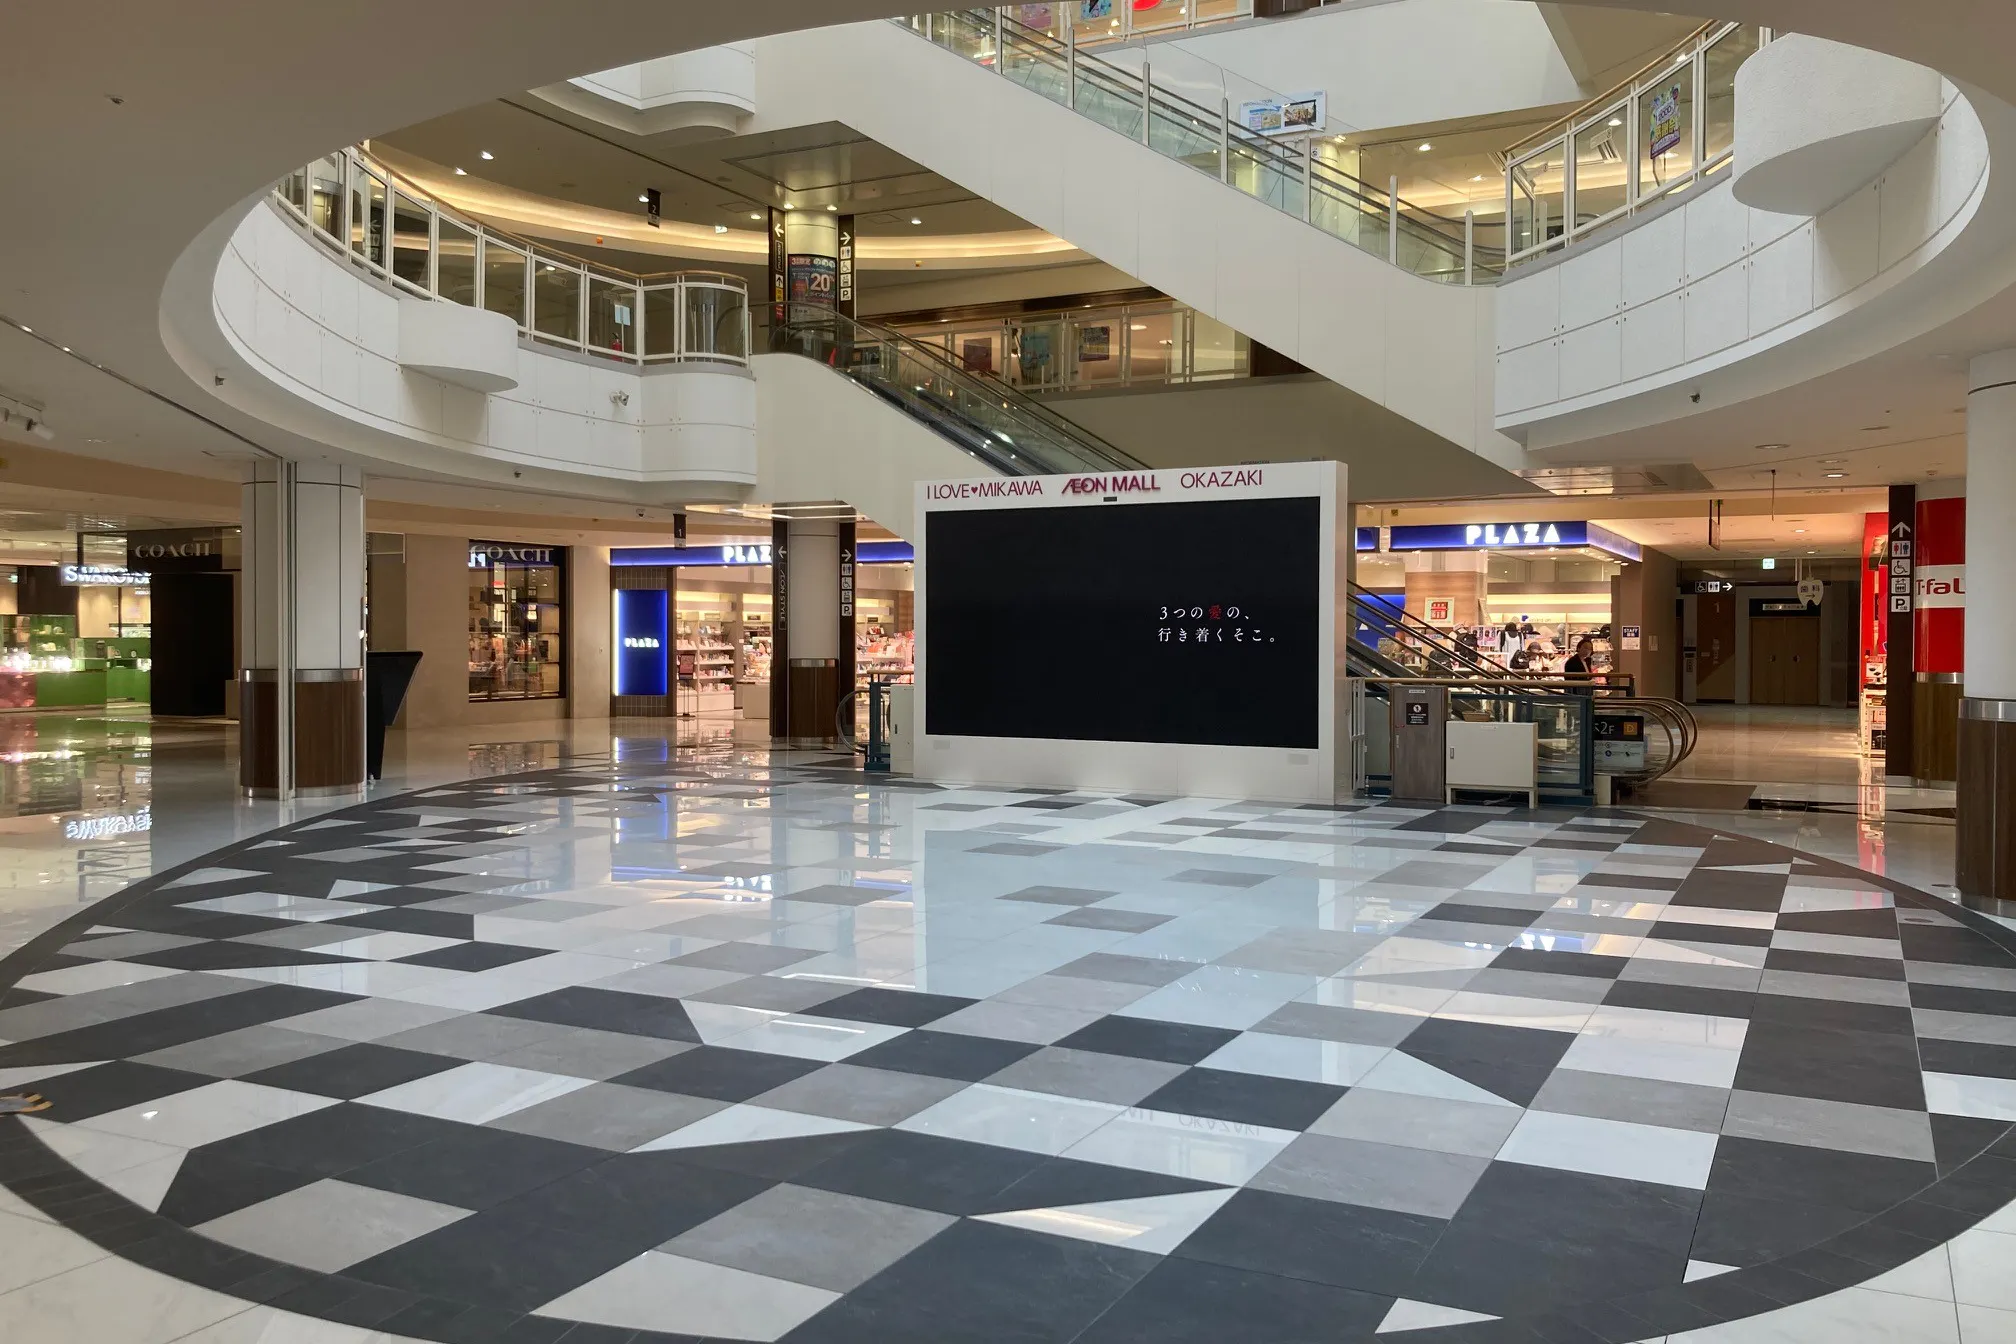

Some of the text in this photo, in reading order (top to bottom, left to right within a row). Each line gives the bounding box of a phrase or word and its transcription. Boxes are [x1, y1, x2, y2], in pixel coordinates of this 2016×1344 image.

[934, 484, 970, 499] LOVE
[979, 480, 1043, 497] MIKAWA
[1112, 474, 1161, 492] MALL
[1180, 469, 1262, 489] OKAZAKI
[1465, 523, 1561, 545] PLAZA
[135, 542, 211, 558] COACH
[470, 545, 552, 563] COACH
[722, 546, 772, 564] PLAZ
[1159, 605, 1250, 620] 3つの愛の、
[624, 637, 660, 648] PLAZA
[1157, 627, 1275, 643] 行き着くそこ。
